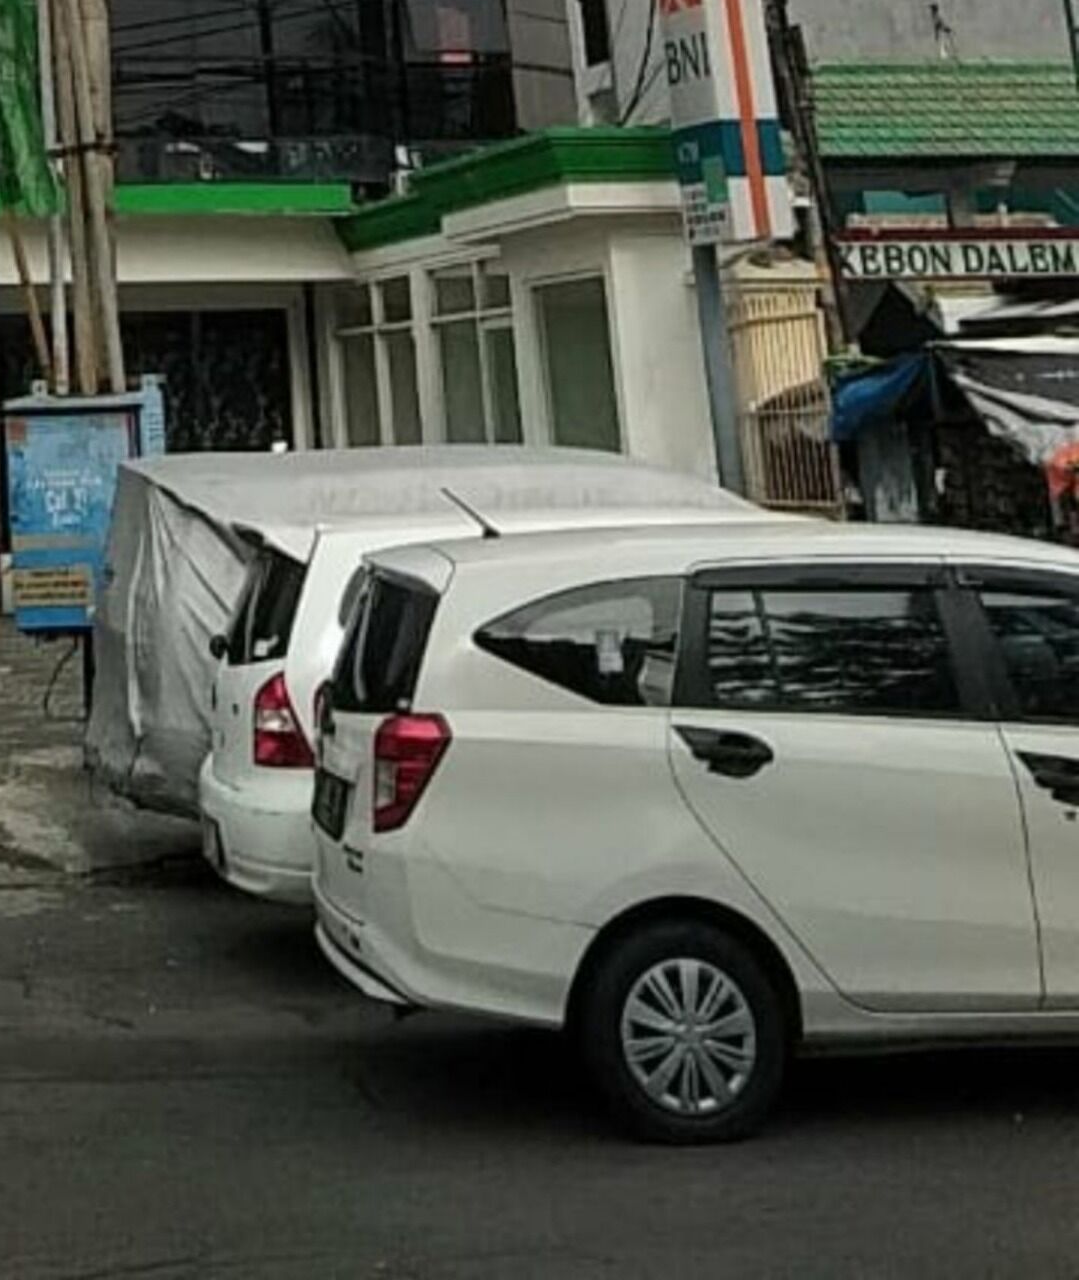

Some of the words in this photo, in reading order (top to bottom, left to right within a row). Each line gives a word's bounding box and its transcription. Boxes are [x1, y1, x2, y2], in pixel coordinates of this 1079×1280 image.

[664, 32, 711, 85] BNI
[838, 244, 952, 276] KEBON
[961, 243, 1077, 274] DALEM
